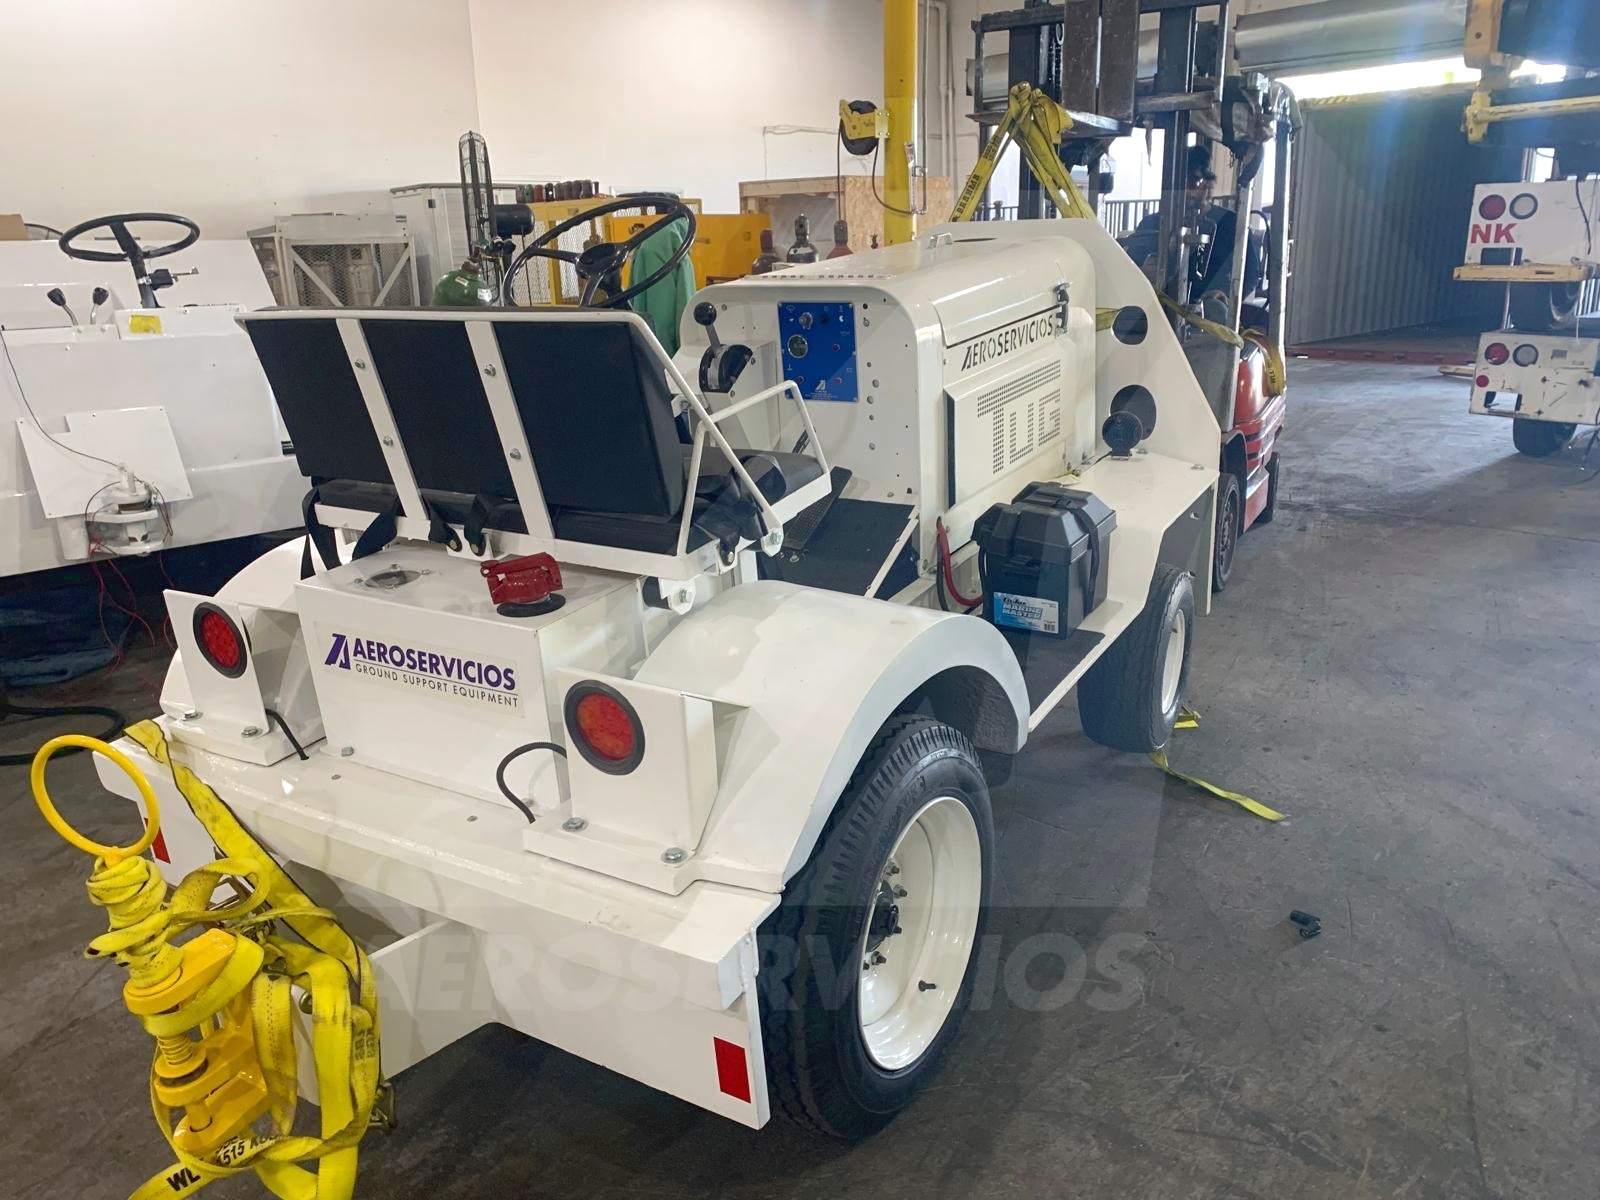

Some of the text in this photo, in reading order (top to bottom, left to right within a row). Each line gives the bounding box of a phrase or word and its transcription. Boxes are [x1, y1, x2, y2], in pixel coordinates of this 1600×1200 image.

[1470, 223, 1517, 244] NK
[961, 314, 1053, 371] AEROSERVICIOS
[977, 359, 1061, 474] TUG
[352, 637, 517, 690] AEROSERVICIOS
[355, 663, 518, 708] GROUND SUPPORT EQUIPMENT
